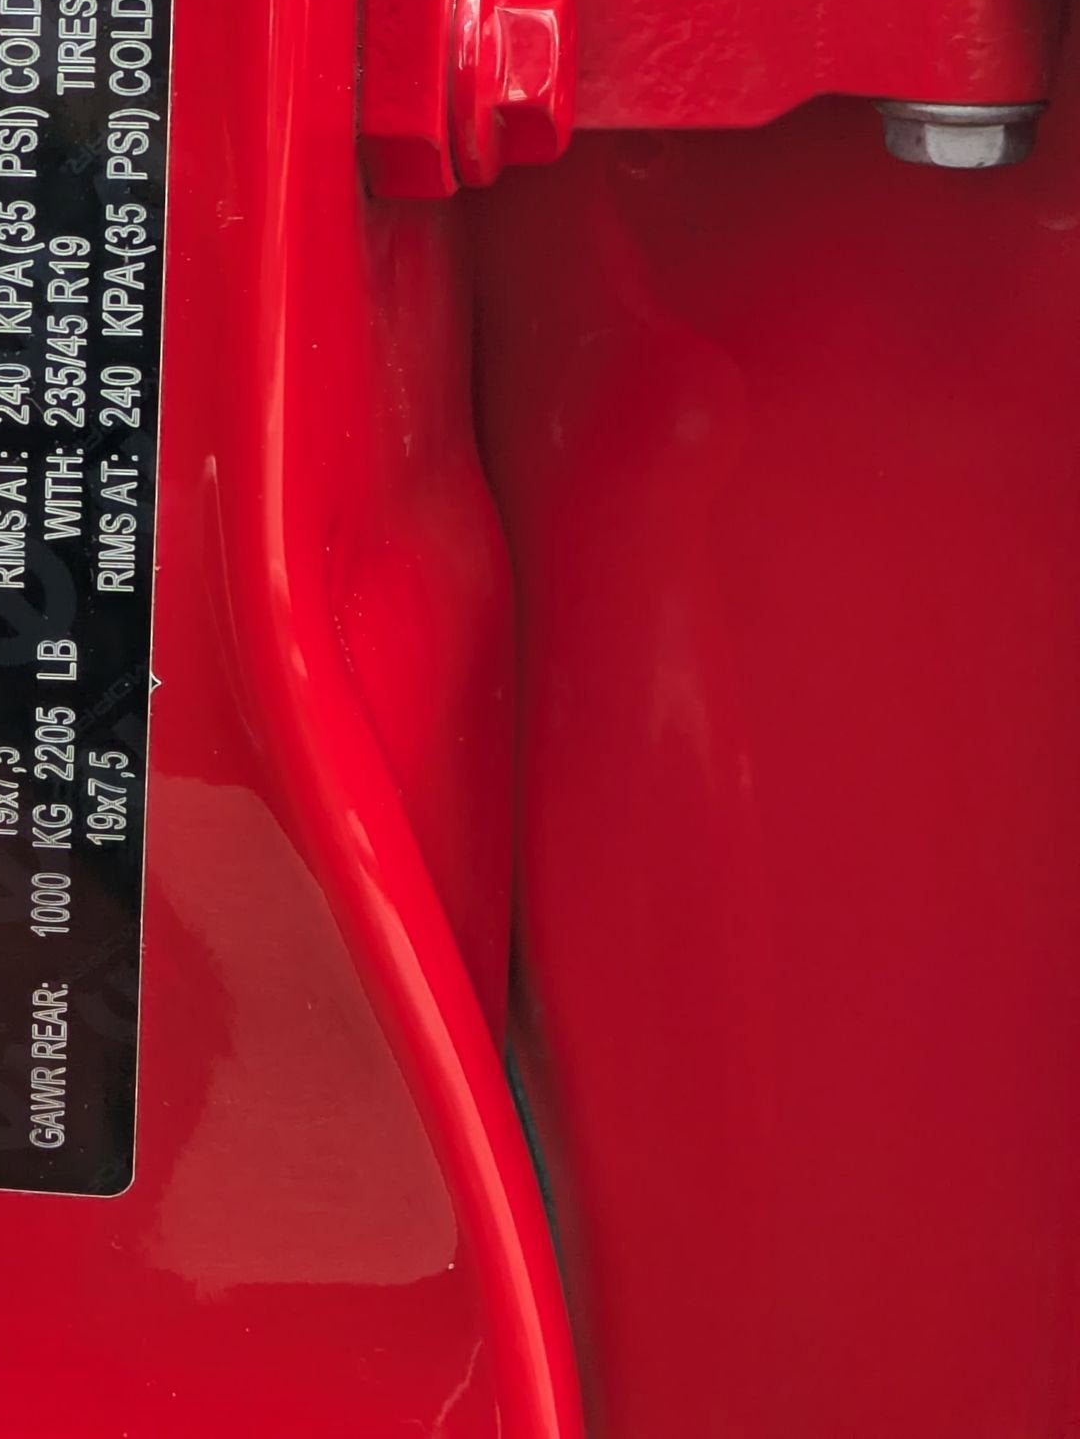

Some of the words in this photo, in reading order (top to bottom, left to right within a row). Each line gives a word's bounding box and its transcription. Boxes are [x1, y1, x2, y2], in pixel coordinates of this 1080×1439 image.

[107, 108, 160, 181] PSI)
[47, 235, 91, 304] R19
[44, 314, 88, 428] 235/45
[99, 365, 143, 428] 240
[43, 447, 85, 540] WITH:
[100, 453, 139, 507] AT:
[97, 512, 137, 593] RIMS
[37, 639, 78, 681] LB
[34, 706, 76, 781] 2205
[32, 803, 73, 849] KG
[87, 750, 135, 846] 19x7,5
[31, 871, 71, 938] 1000
[32, 983, 69, 1060] REAR:
[30, 1066, 67, 1149] GAWR
